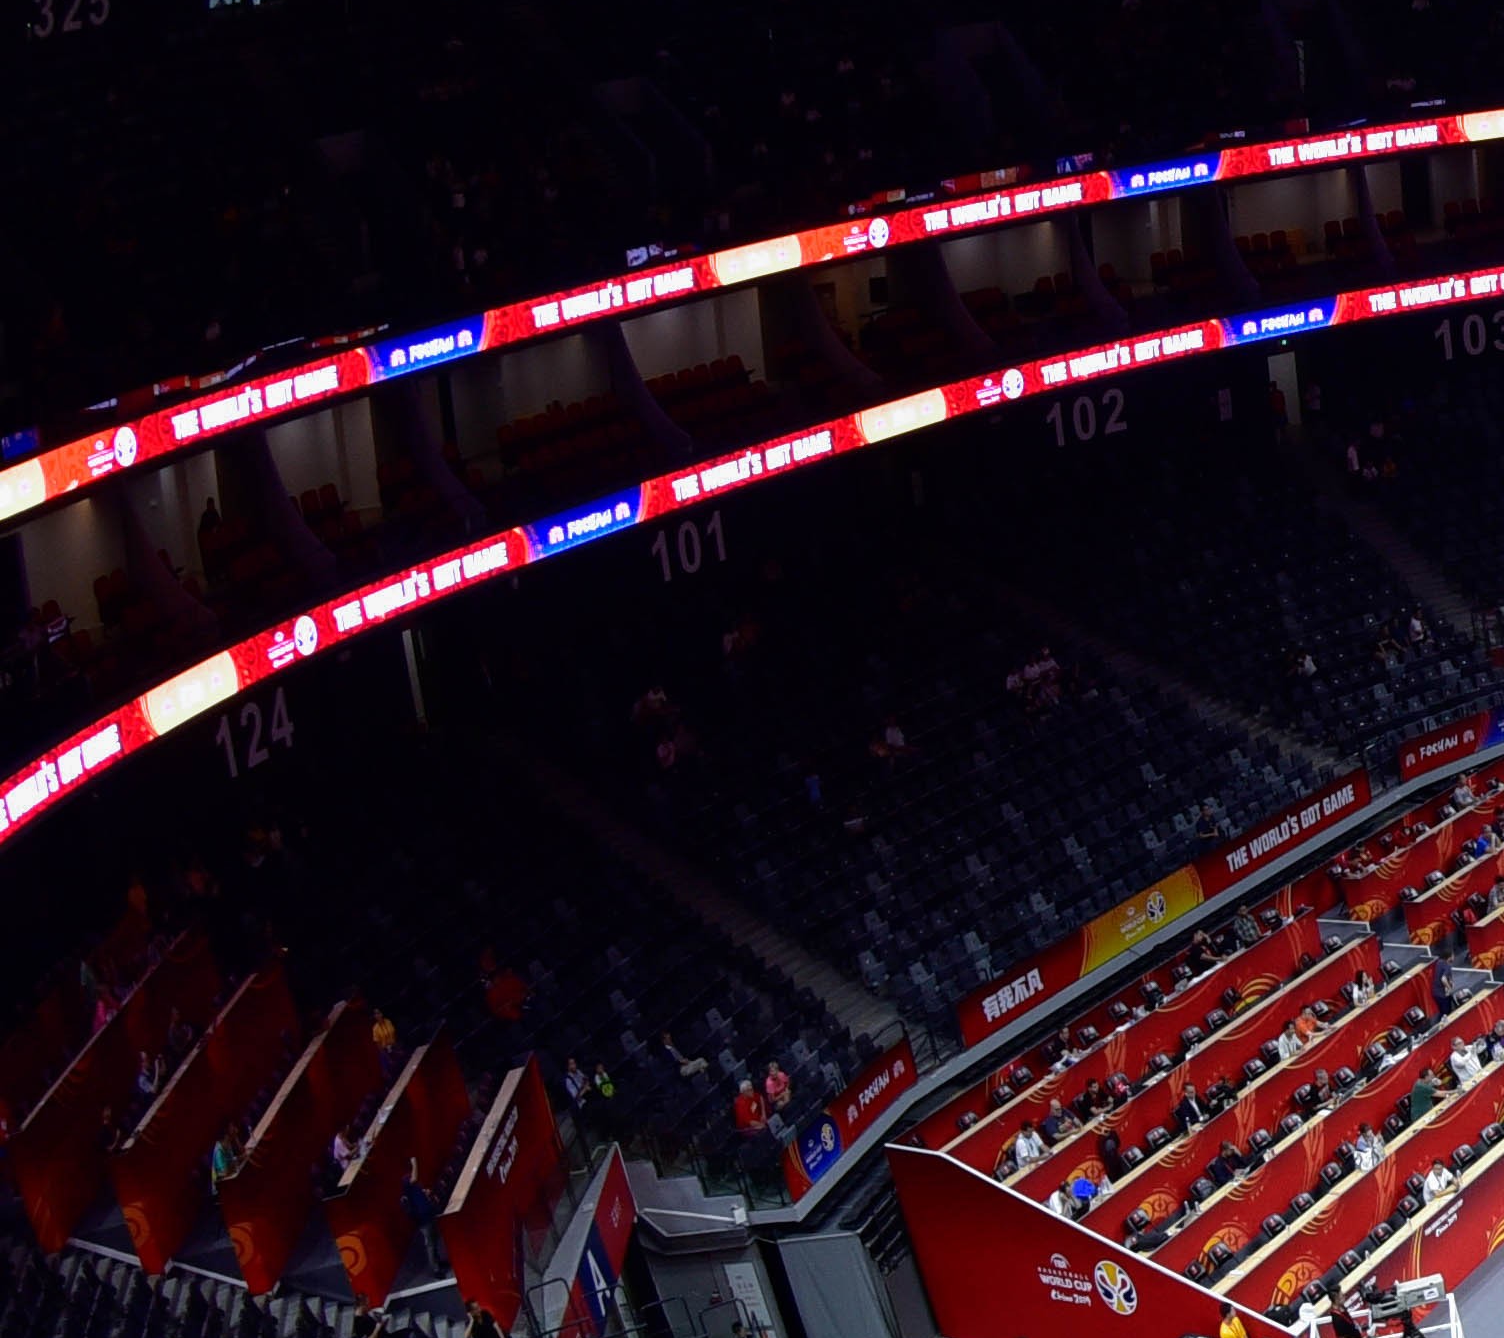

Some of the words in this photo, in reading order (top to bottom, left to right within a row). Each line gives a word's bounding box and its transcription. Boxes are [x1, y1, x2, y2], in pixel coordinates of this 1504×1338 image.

[924, 210, 948, 232] THE
[951, 194, 1011, 227] WORLD'S
[1041, 182, 1082, 207] GAME
[1044, 387, 1127, 447] 102
[651, 509, 728, 581] 101
[217, 687, 295, 778] 124
[1226, 848, 1250, 873] THE
[1249, 814, 1299, 859] WORLD'S
[1299, 805, 1322, 830] GOT
[1322, 784, 1355, 816] GAME
[982, 968, 1045, 1022] 有我不凡
[1039, 1274, 1073, 1288] WORLD
[1073, 1279, 1092, 1292] CUP
